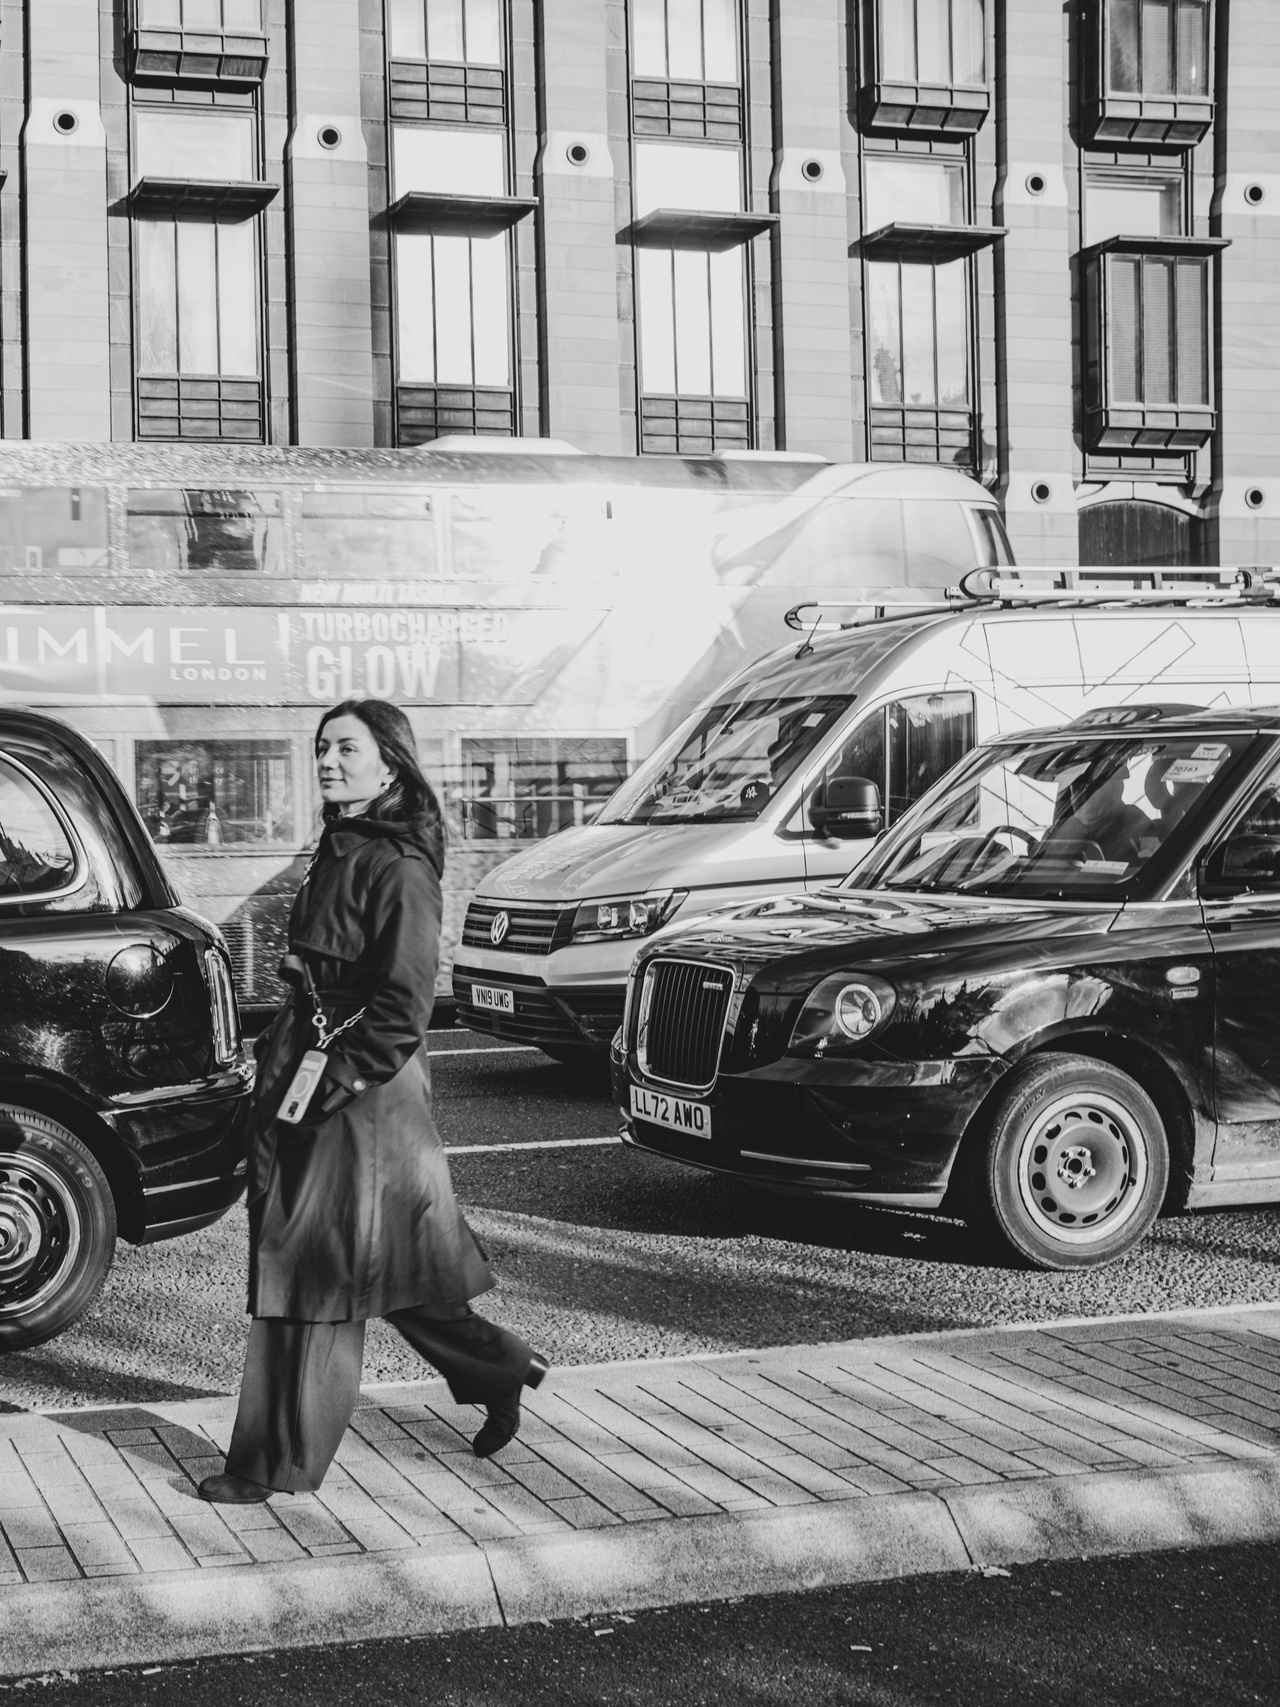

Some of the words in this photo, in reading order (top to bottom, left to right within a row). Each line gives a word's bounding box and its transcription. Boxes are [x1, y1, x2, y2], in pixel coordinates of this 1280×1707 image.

[299, 611, 511, 643] TURBOCHARGED
[170, 667, 267, 681] LONDON
[306, 644, 442, 699] GLOW
[476, 987, 493, 1006] VN19
[493, 990, 510, 1008] UWG
[635, 1089, 669, 1122] LL72
[674, 1101, 704, 1131] AWO
